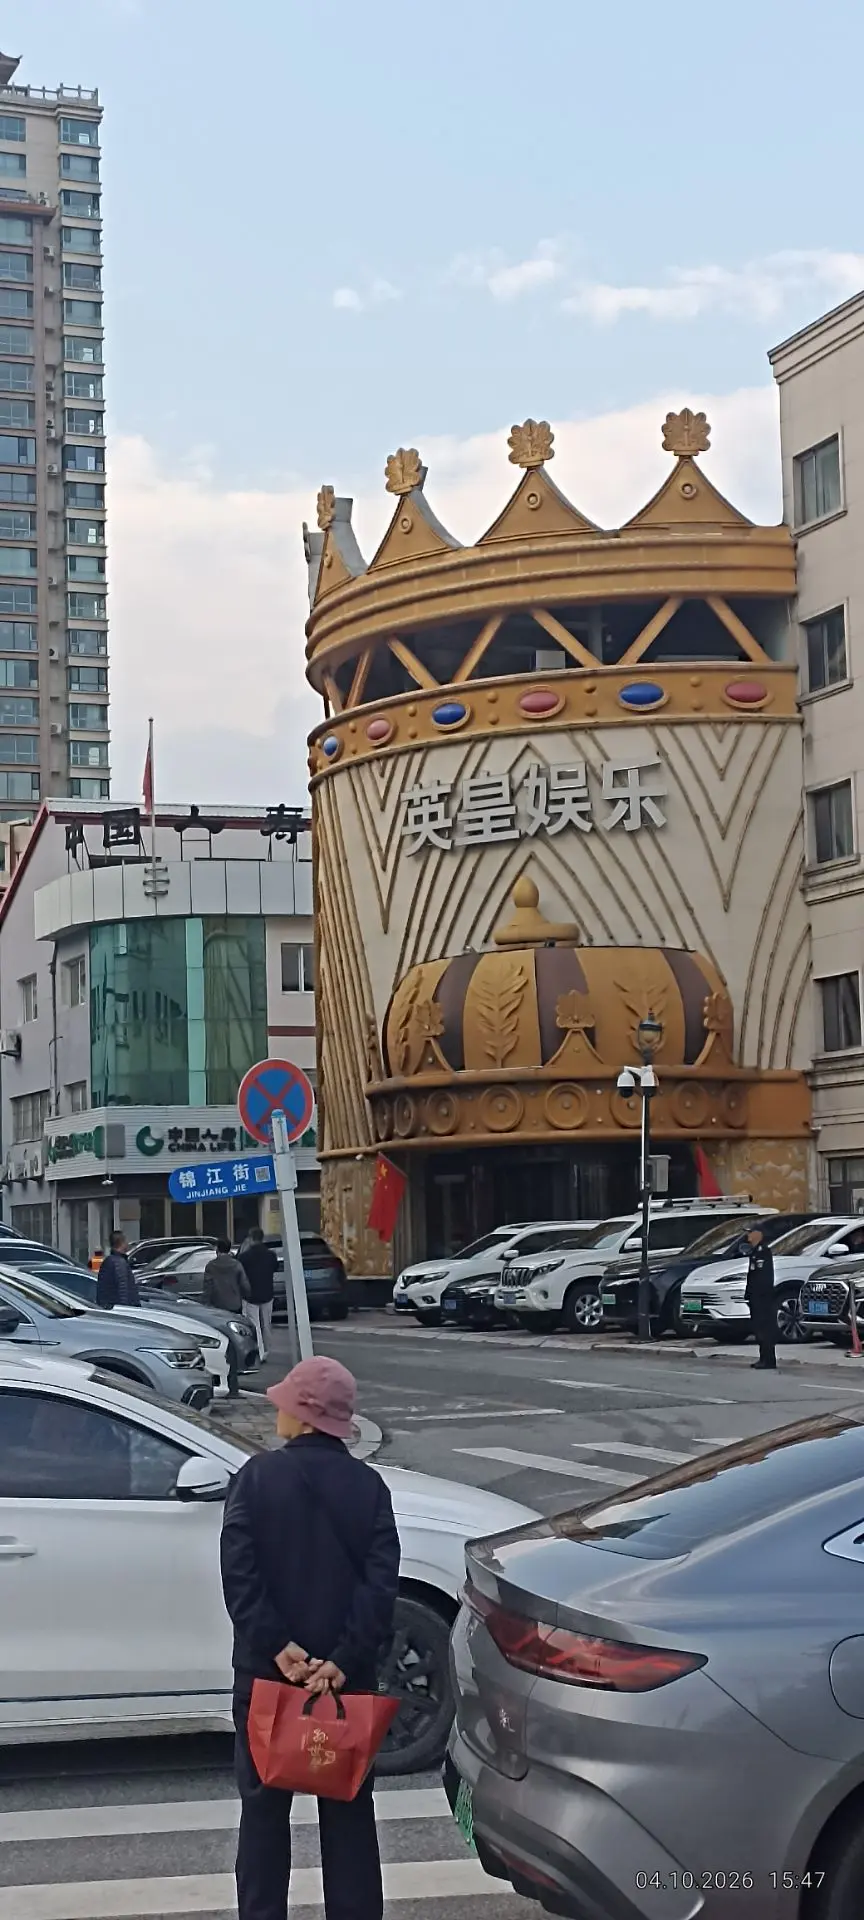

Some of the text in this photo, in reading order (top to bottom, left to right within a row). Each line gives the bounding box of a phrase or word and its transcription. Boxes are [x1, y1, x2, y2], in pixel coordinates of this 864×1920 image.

[401, 758, 668, 857] 英皇娱乐
[65, 803, 304, 859] 中国人寿
[179, 1163, 250, 1189] 锦江街
[186, 1183, 248, 1199] JINJIANG JIE
